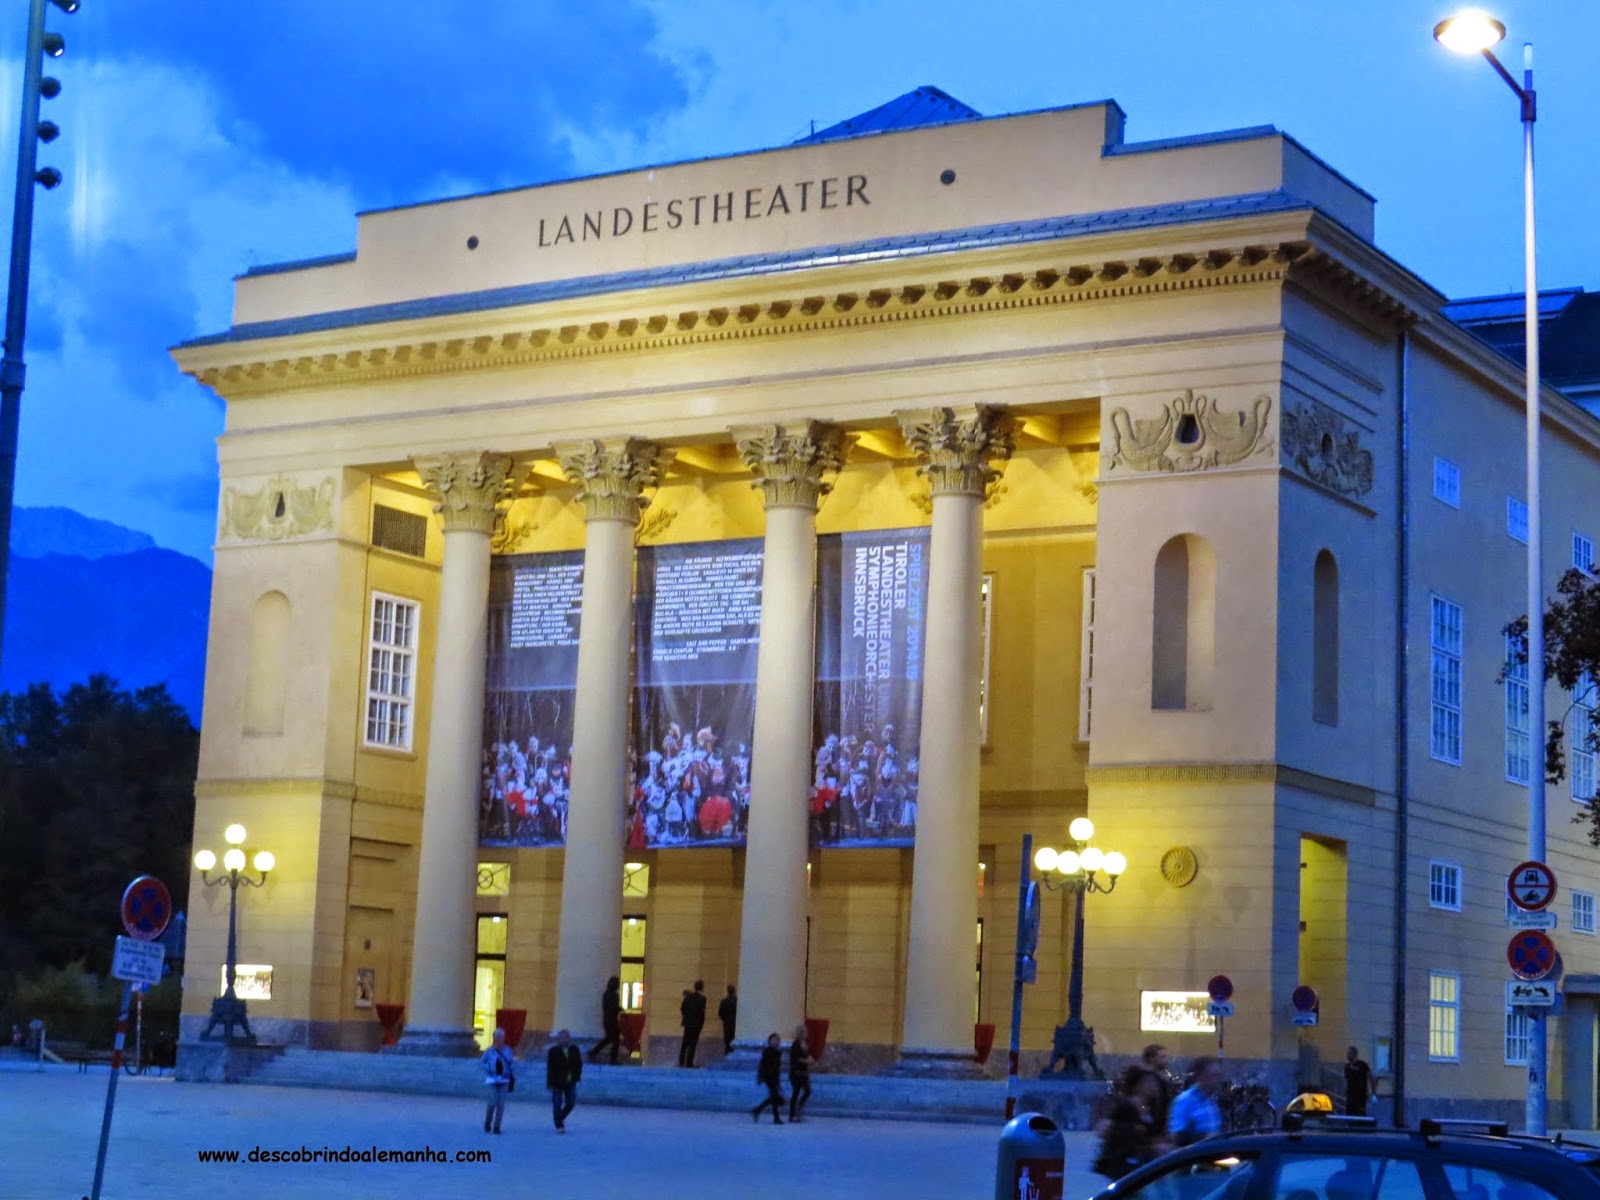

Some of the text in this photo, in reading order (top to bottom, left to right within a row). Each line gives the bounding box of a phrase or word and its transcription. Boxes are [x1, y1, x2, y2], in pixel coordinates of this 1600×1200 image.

[538, 174, 871, 247] LANDESTHEATER
[853, 547, 867, 638] INNSBRUCK
[878, 545, 895, 680] LANDESTHEATER
[894, 541, 908, 610] TIROLER
